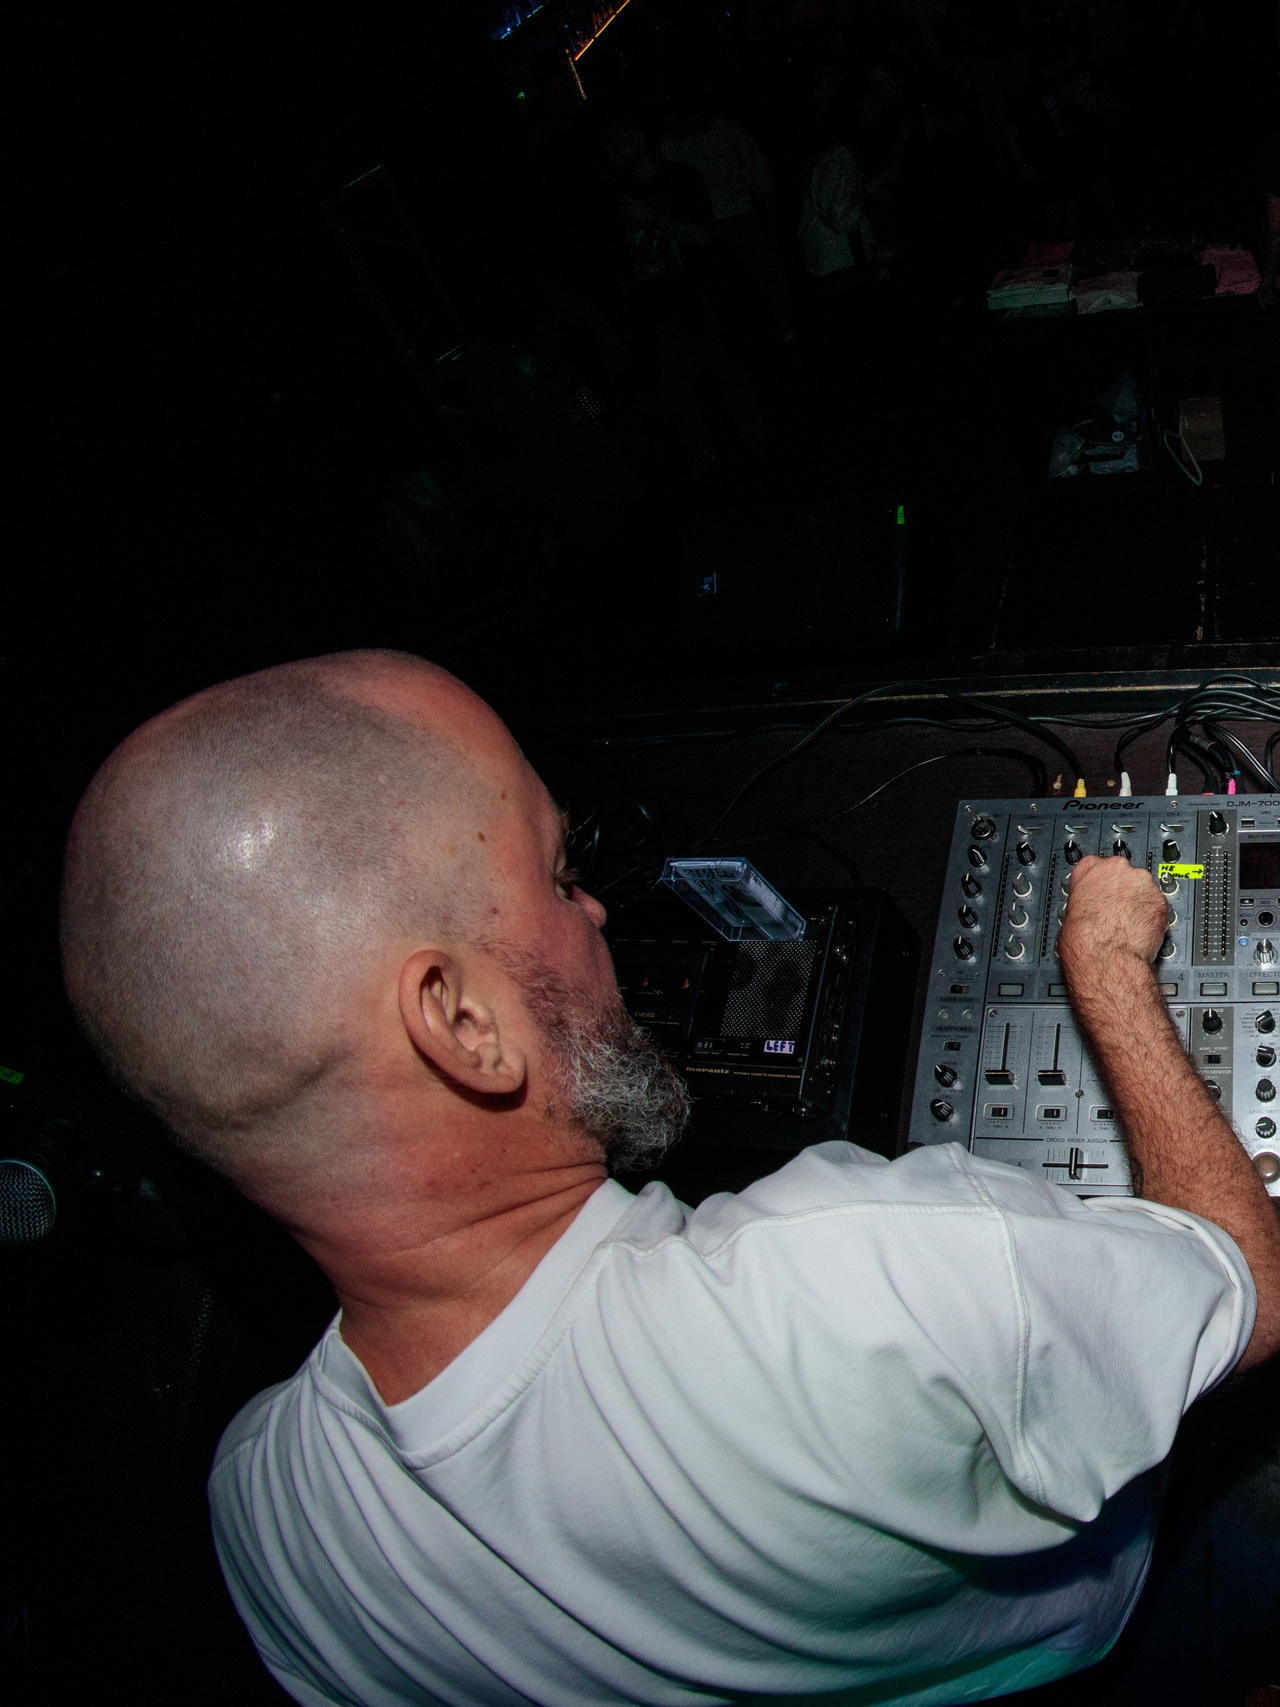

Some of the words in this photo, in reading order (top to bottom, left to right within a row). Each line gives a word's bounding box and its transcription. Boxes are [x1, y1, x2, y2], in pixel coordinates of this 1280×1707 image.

[1062, 800, 1145, 811] Pioneer
[1177, 973, 1185, 981] 4
[766, 1041, 795, 1052] LEFT
[685, 1066, 730, 1074] marantz
